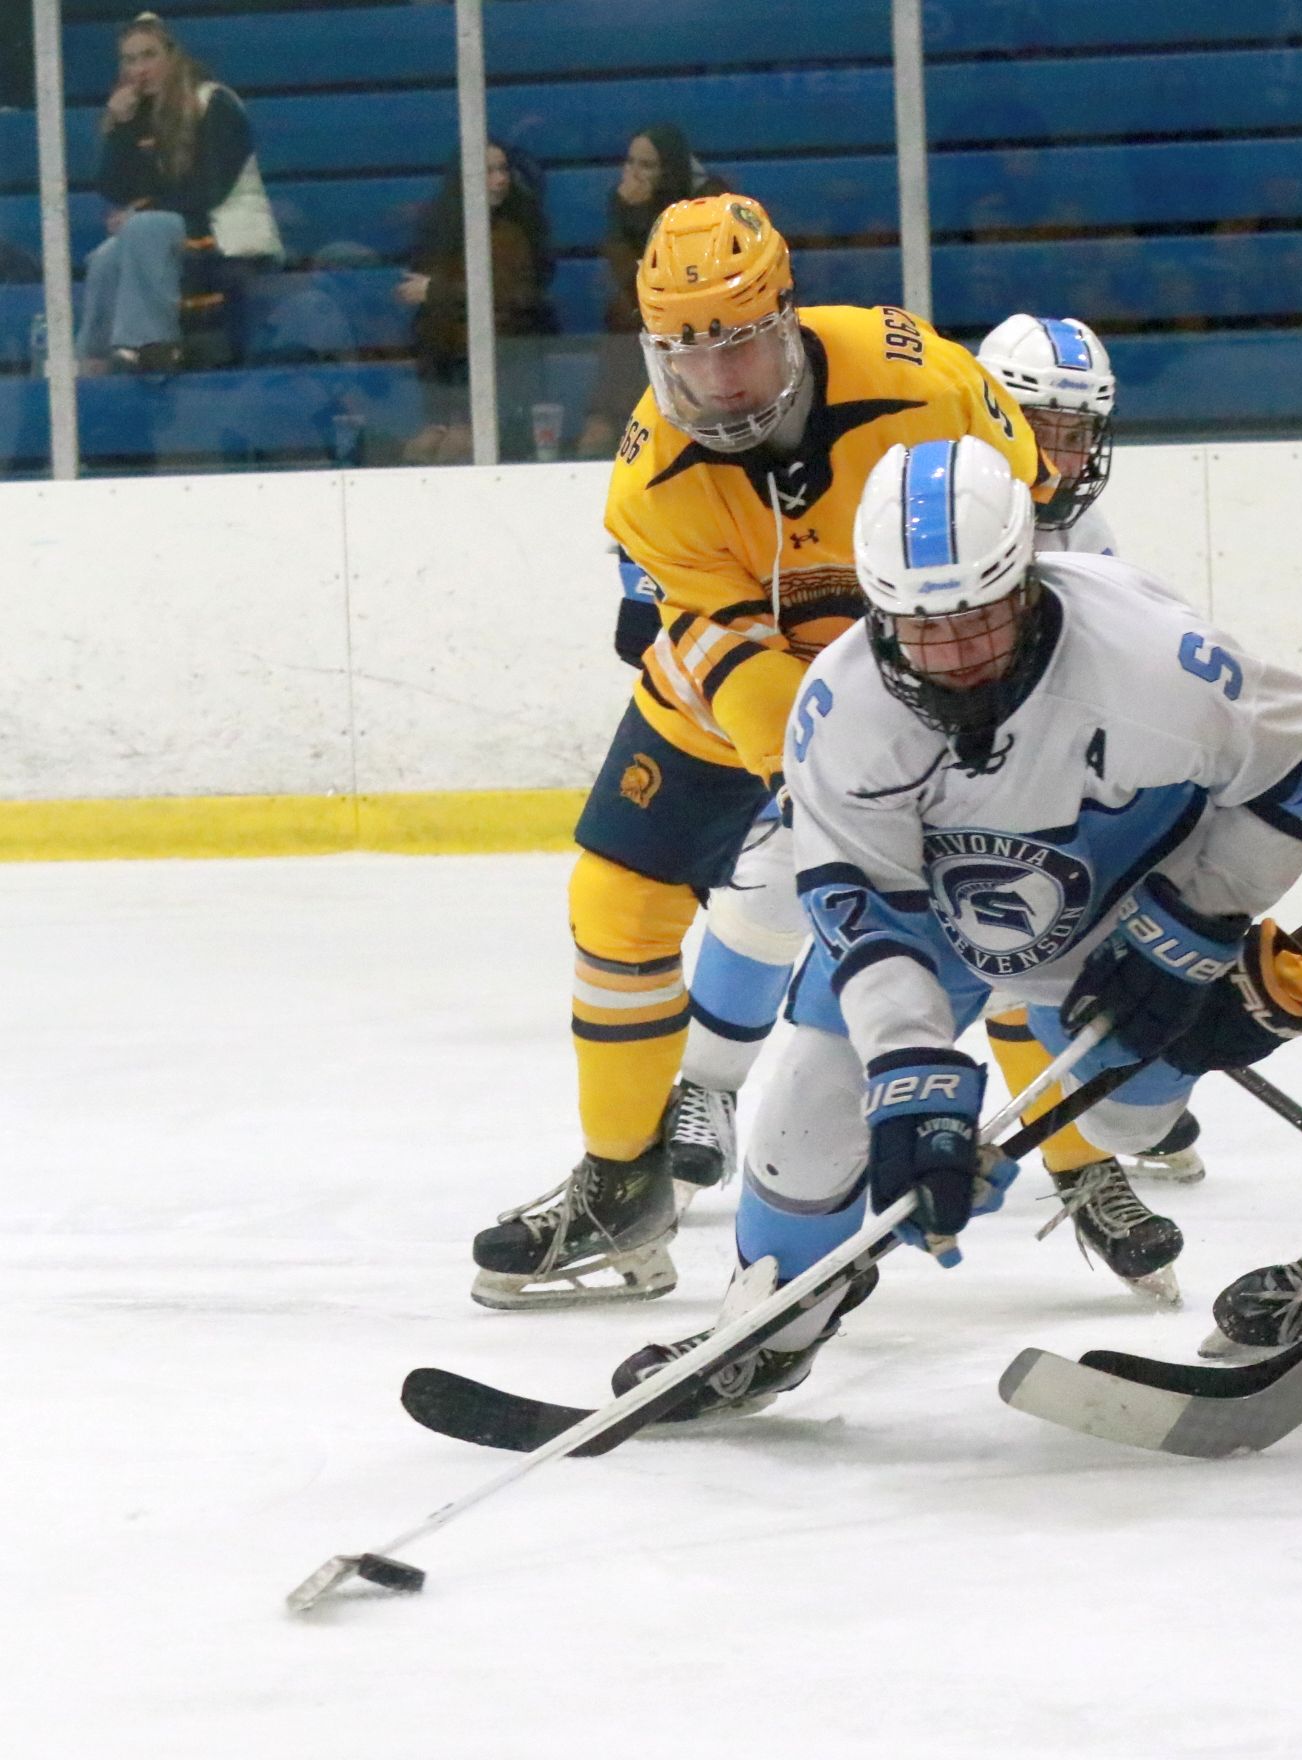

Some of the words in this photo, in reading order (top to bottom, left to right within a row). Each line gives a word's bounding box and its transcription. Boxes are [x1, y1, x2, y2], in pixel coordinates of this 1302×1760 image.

[685, 264, 699, 284] 5
[882, 306, 924, 366] 1967
[1085, 727, 1106, 780] A
[926, 834, 1050, 867] LIVONIA
[862, 1073, 960, 1117] UER
